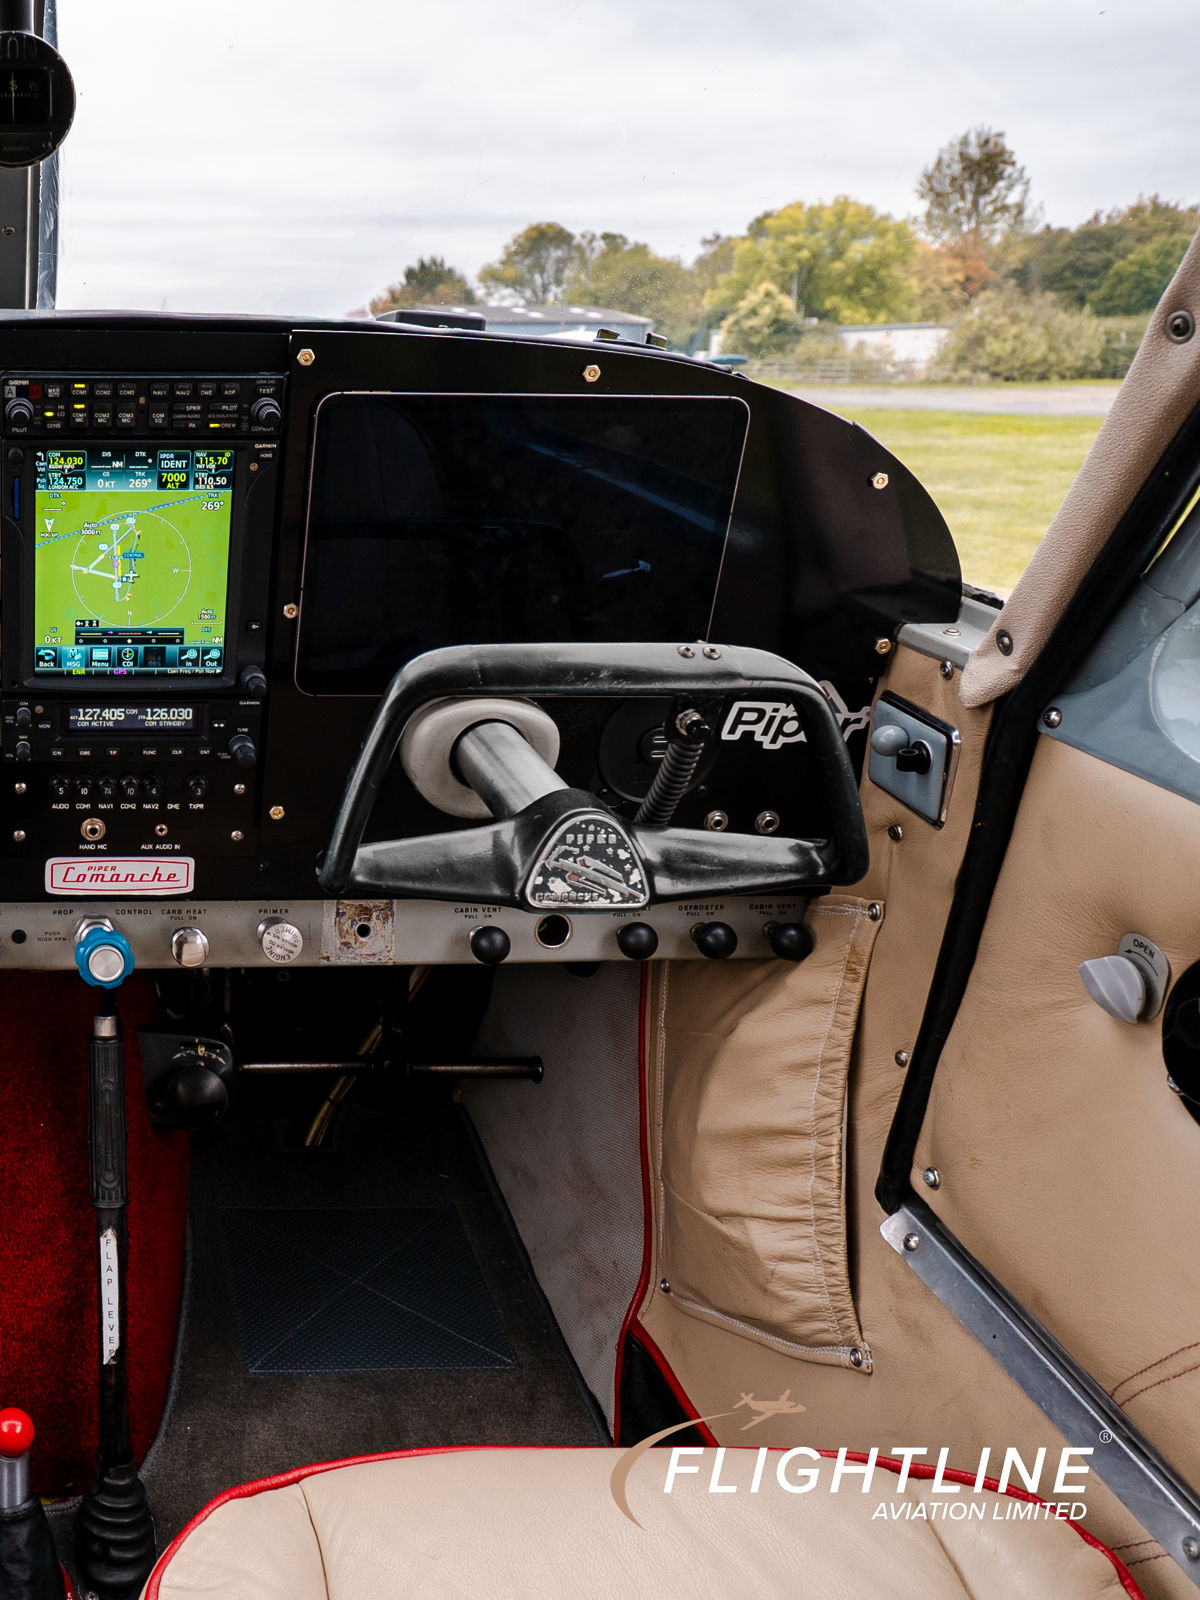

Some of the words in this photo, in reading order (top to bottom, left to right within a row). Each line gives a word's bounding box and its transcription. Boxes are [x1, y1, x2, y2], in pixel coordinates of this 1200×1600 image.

[49, 457, 84, 465] 124.030
[161, 460, 188, 468] IDENT
[199, 457, 228, 465] 115.70
[49, 477, 83, 485] 124.750
[161, 473, 186, 482] 7000
[198, 477, 227, 485] 110.50
[78, 708, 125, 721] 127.405
[145, 708, 193, 721] 126.030
[62, 866, 181, 884] Comanche
[1133, 939, 1155, 958] OPEN
